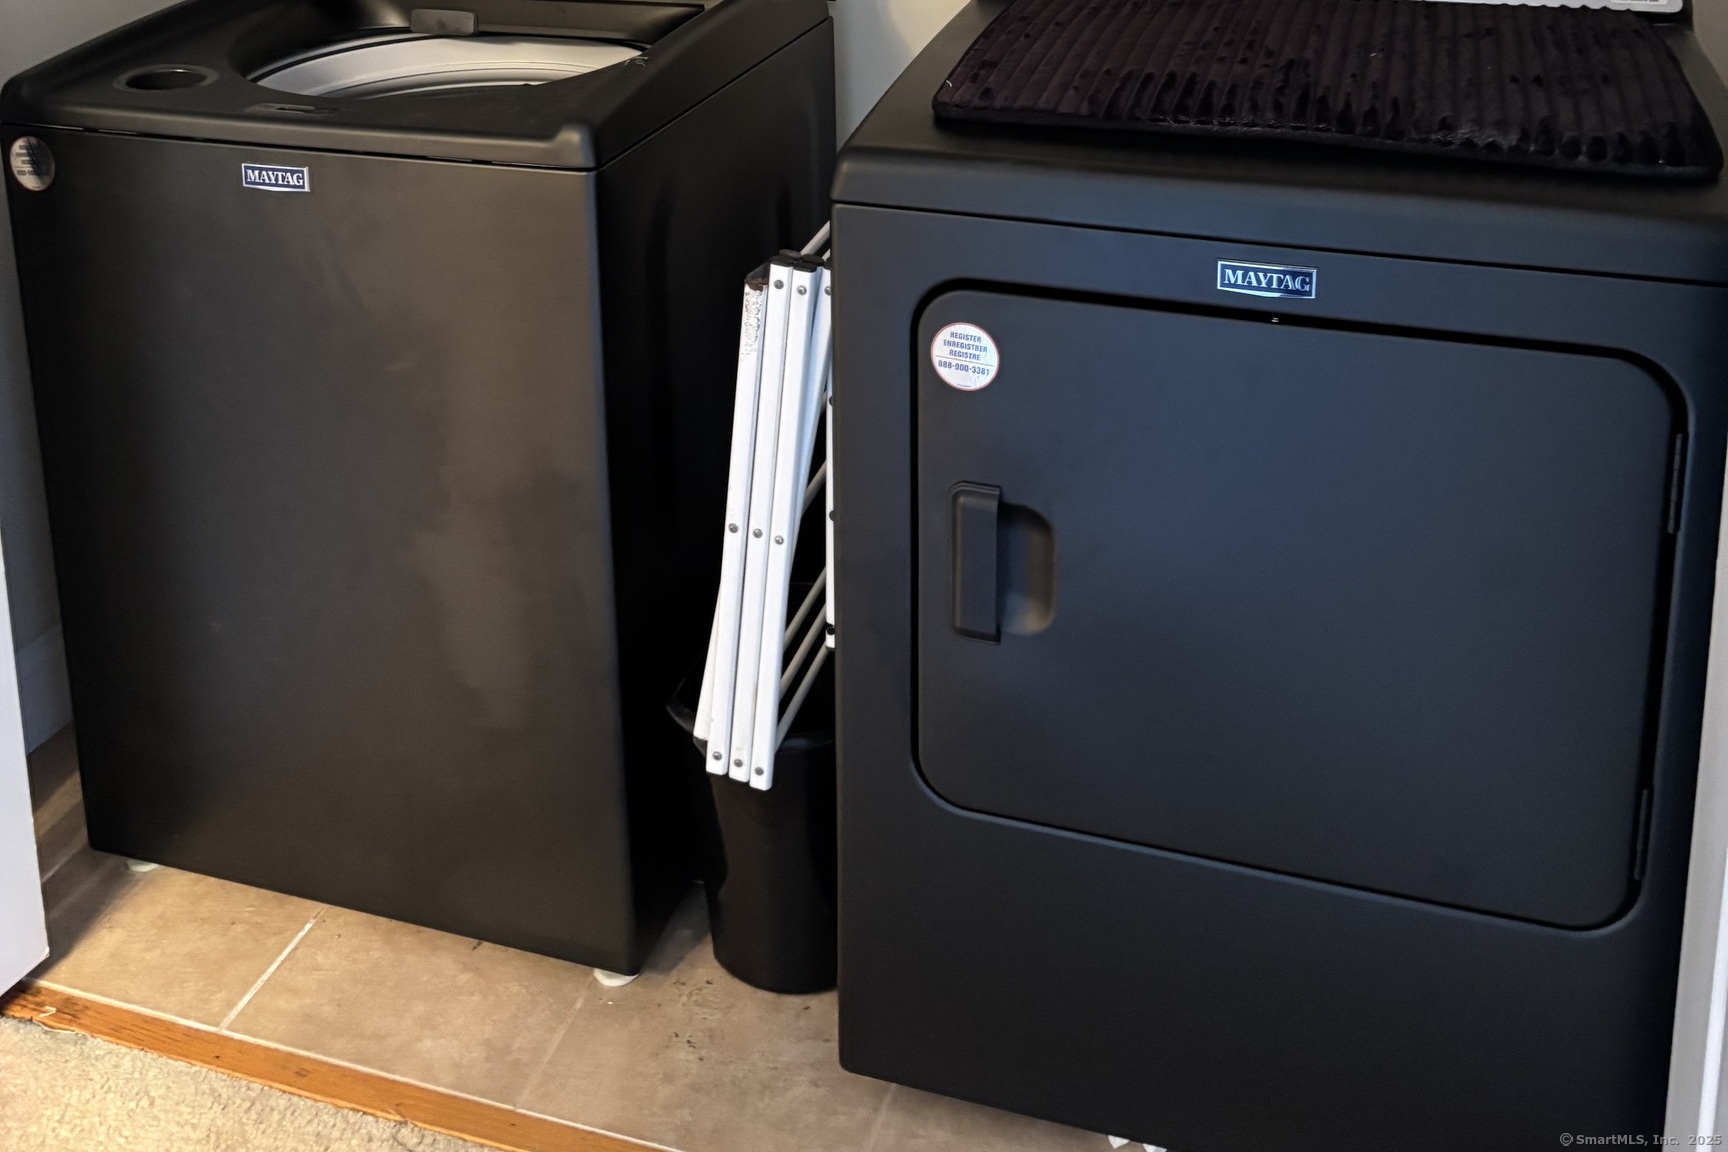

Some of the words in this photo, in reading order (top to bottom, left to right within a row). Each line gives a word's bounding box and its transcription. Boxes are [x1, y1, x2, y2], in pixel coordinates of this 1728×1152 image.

[245, 169, 304, 186] MAYTAG
[1223, 268, 1311, 292] MAYTAG
[950, 331, 982, 343] REGISTER
[943, 339, 988, 353] ENREGISTRER
[949, 349, 981, 361] REGISTRE
